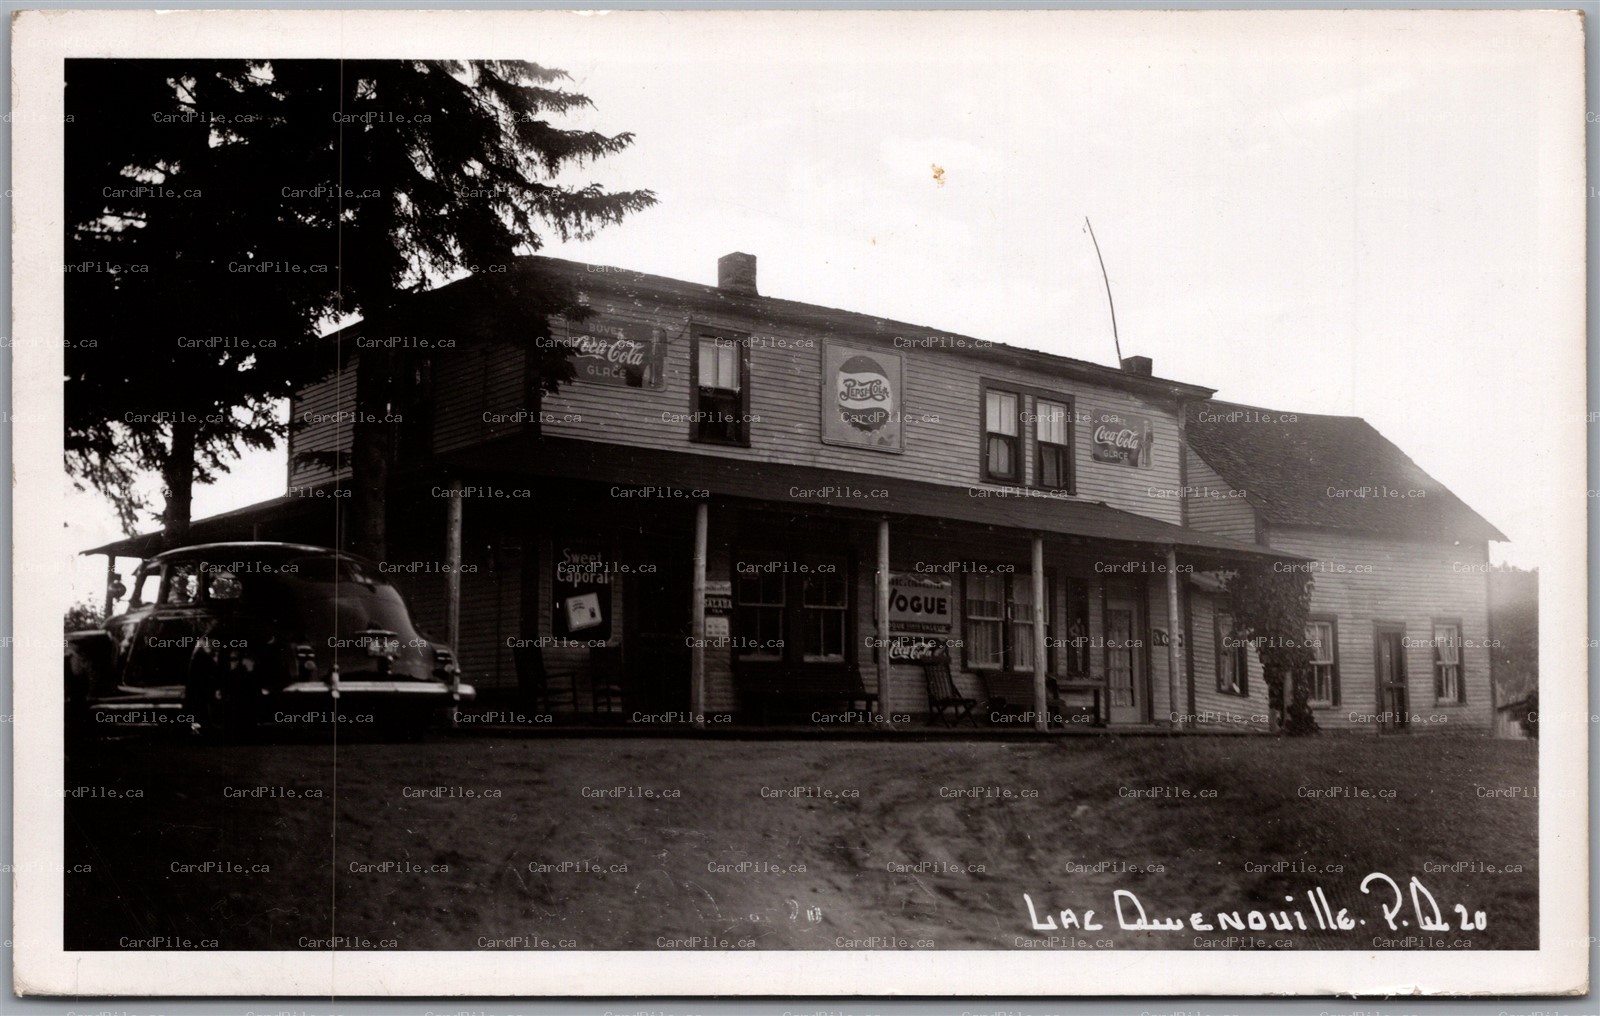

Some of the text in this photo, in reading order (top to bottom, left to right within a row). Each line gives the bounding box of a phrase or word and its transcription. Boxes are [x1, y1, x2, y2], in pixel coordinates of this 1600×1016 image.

[562, 547, 602, 565] Sweet
[556, 564, 609, 588] Caporal
[1454, 903, 1487, 930] 20
